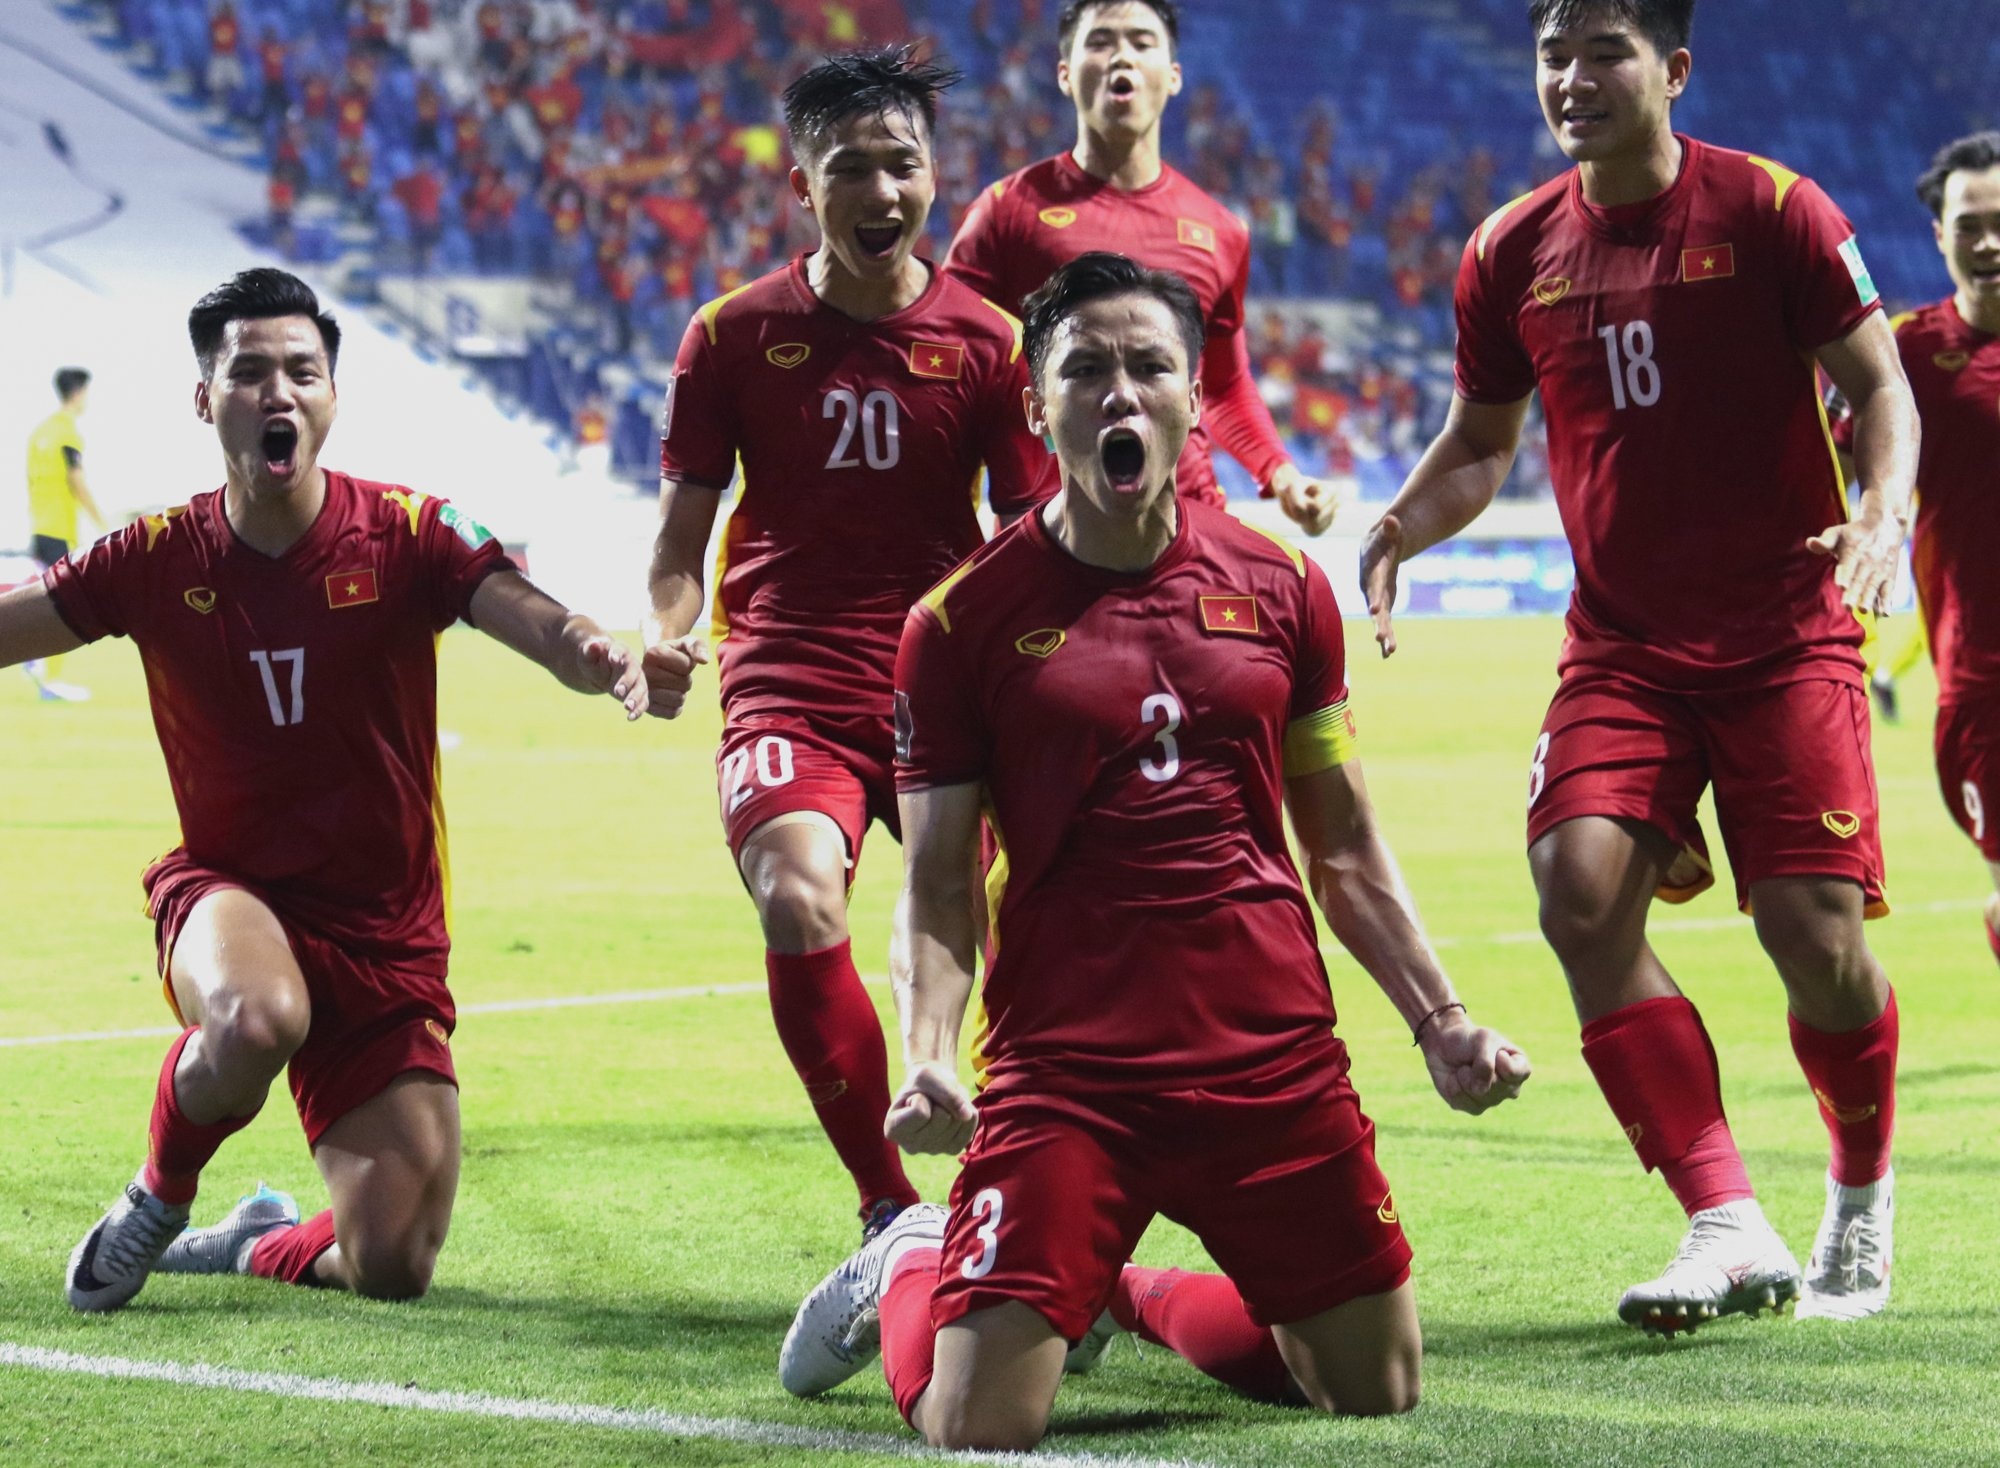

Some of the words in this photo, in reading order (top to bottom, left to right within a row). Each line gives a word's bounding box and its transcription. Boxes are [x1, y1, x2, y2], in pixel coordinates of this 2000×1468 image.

[1598, 320, 1661, 409] 18
[822, 389, 900, 470] 20
[248, 648, 304, 726] 17
[722, 735, 795, 816] 20
[1140, 693, 1180, 782] 3
[1961, 781, 1985, 840] 9
[960, 1189, 1004, 1280] 3
